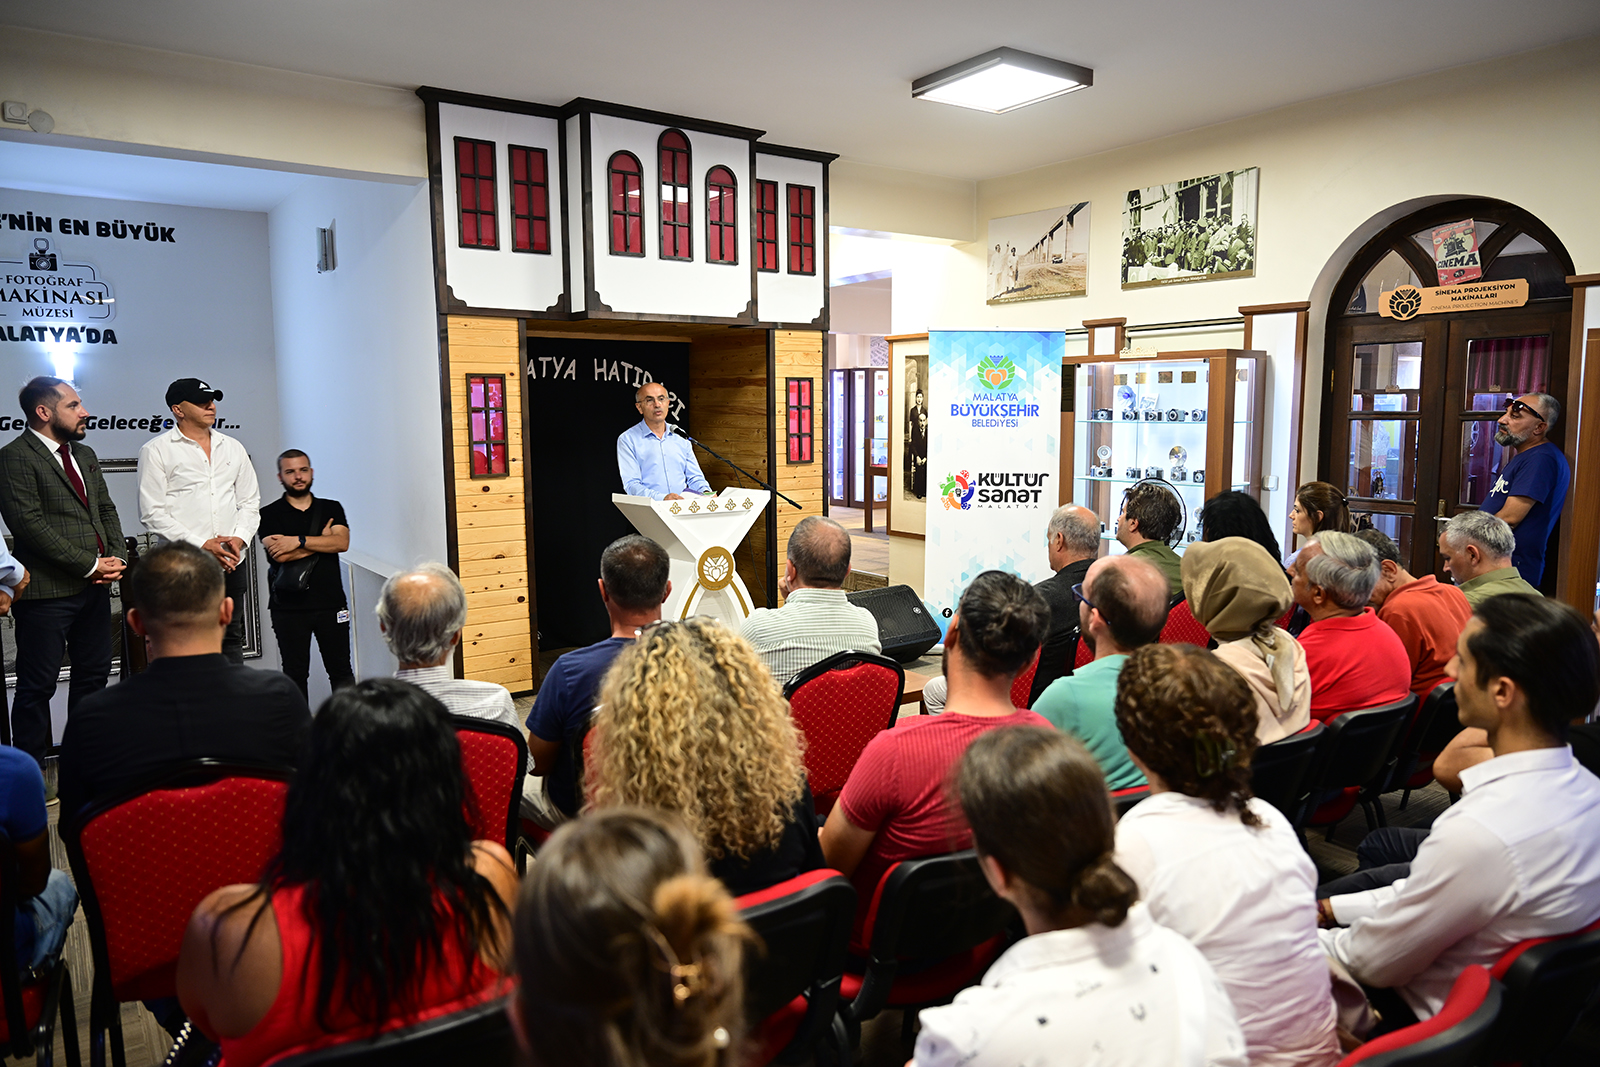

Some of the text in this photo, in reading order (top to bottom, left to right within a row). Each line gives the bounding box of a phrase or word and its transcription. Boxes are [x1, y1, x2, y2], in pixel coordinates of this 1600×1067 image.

[0, 211, 176, 243] 'NİN EN BÜYÜK
[1437, 253, 1478, 268] CINEMA
[6, 274, 84, 287] FOTOĞRAF
[1464, 283, 1516, 293] PROJEKSİYON
[1451, 293, 1498, 302] MAKİNALARI
[22, 306, 74, 318] MÜZESİ
[972, 393, 1019, 402] MALATYA
[950, 404, 1040, 419] BÜYÜKŞEHİR
[85, 414, 175, 433] Geleceğe
[971, 419, 1019, 428] BELEDİYESİ
